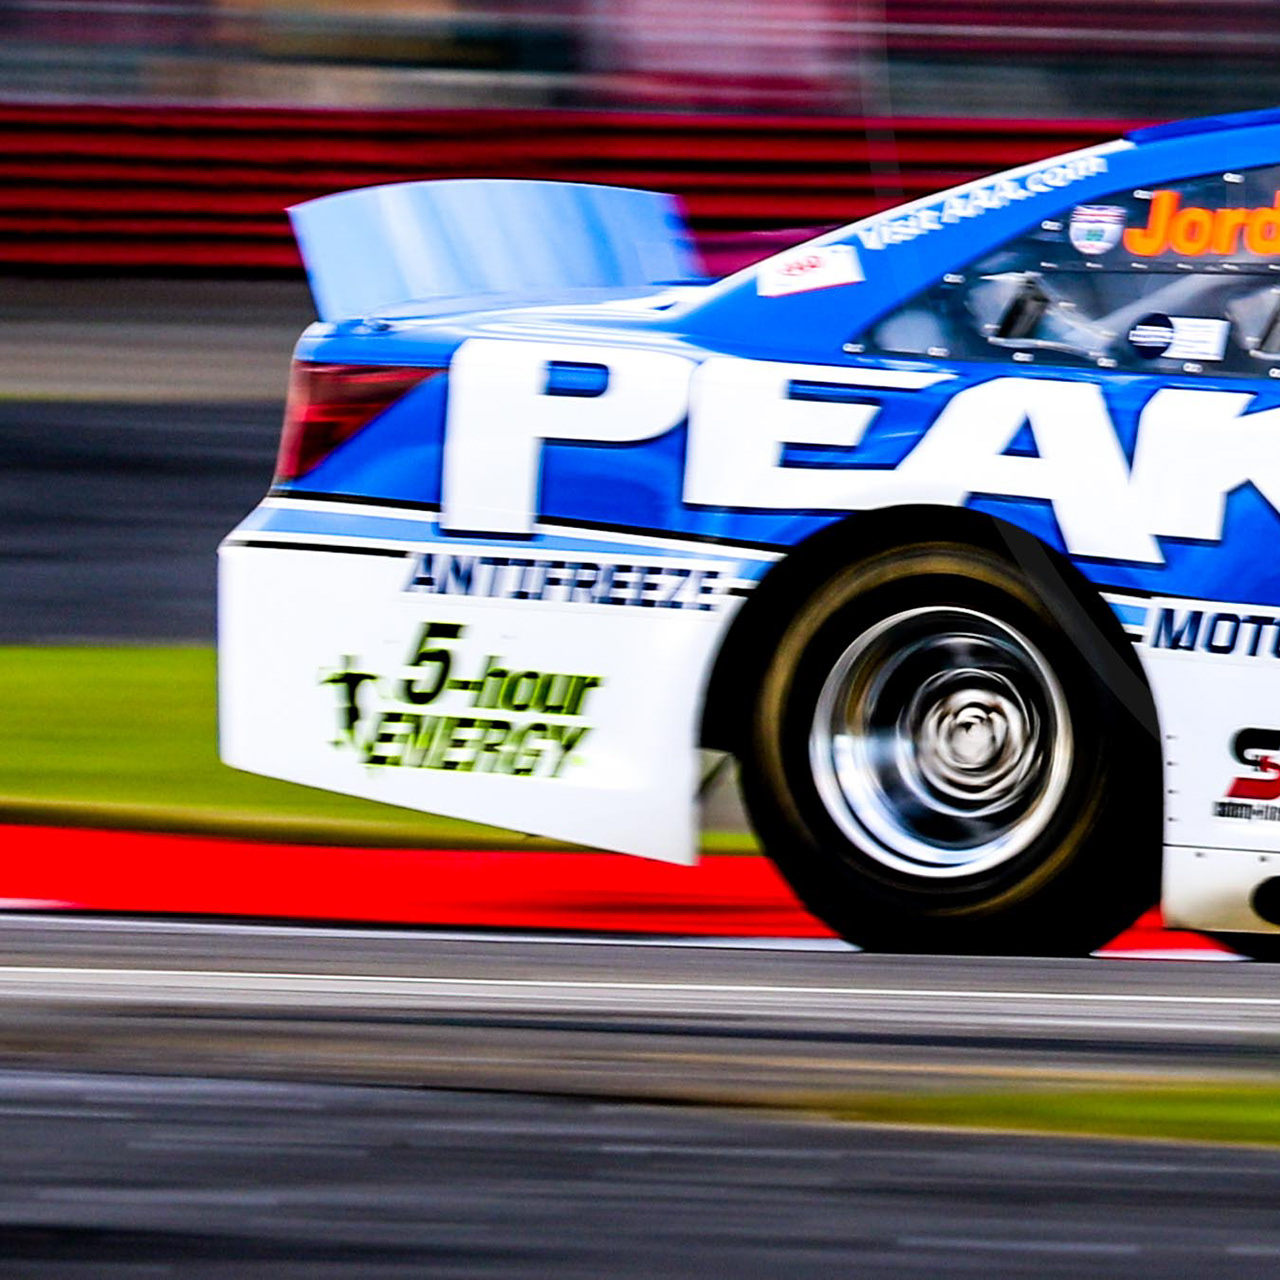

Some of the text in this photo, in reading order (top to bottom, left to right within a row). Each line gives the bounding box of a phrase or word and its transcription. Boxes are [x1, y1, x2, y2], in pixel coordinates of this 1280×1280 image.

[402, 553, 721, 612] ANTIFREEZE
[396, 622, 606, 716] 5-hour
[362, 711, 597, 778] ENERGY
